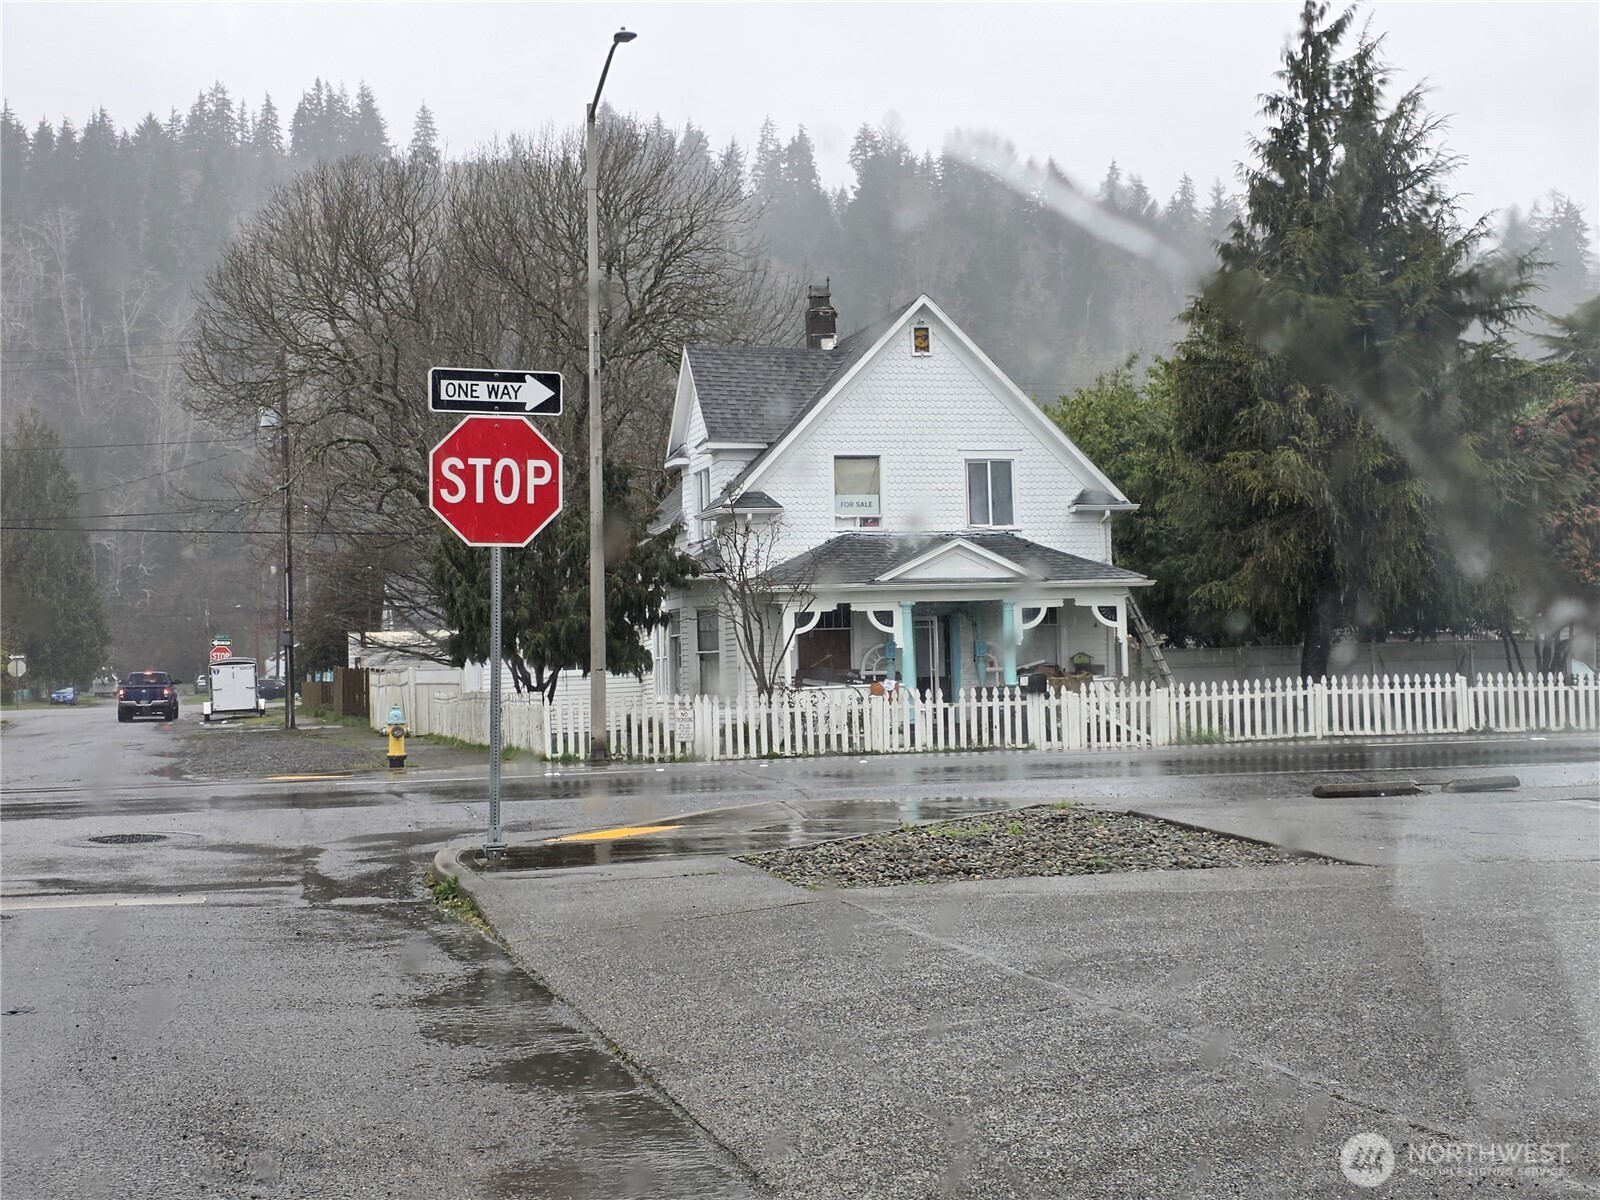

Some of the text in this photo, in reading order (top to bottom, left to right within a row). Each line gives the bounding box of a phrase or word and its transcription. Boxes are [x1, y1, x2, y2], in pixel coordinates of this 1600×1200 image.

[445, 382, 523, 400] ONE WAY
[439, 457, 553, 505] STOP
[212, 652, 231, 661] STOP
